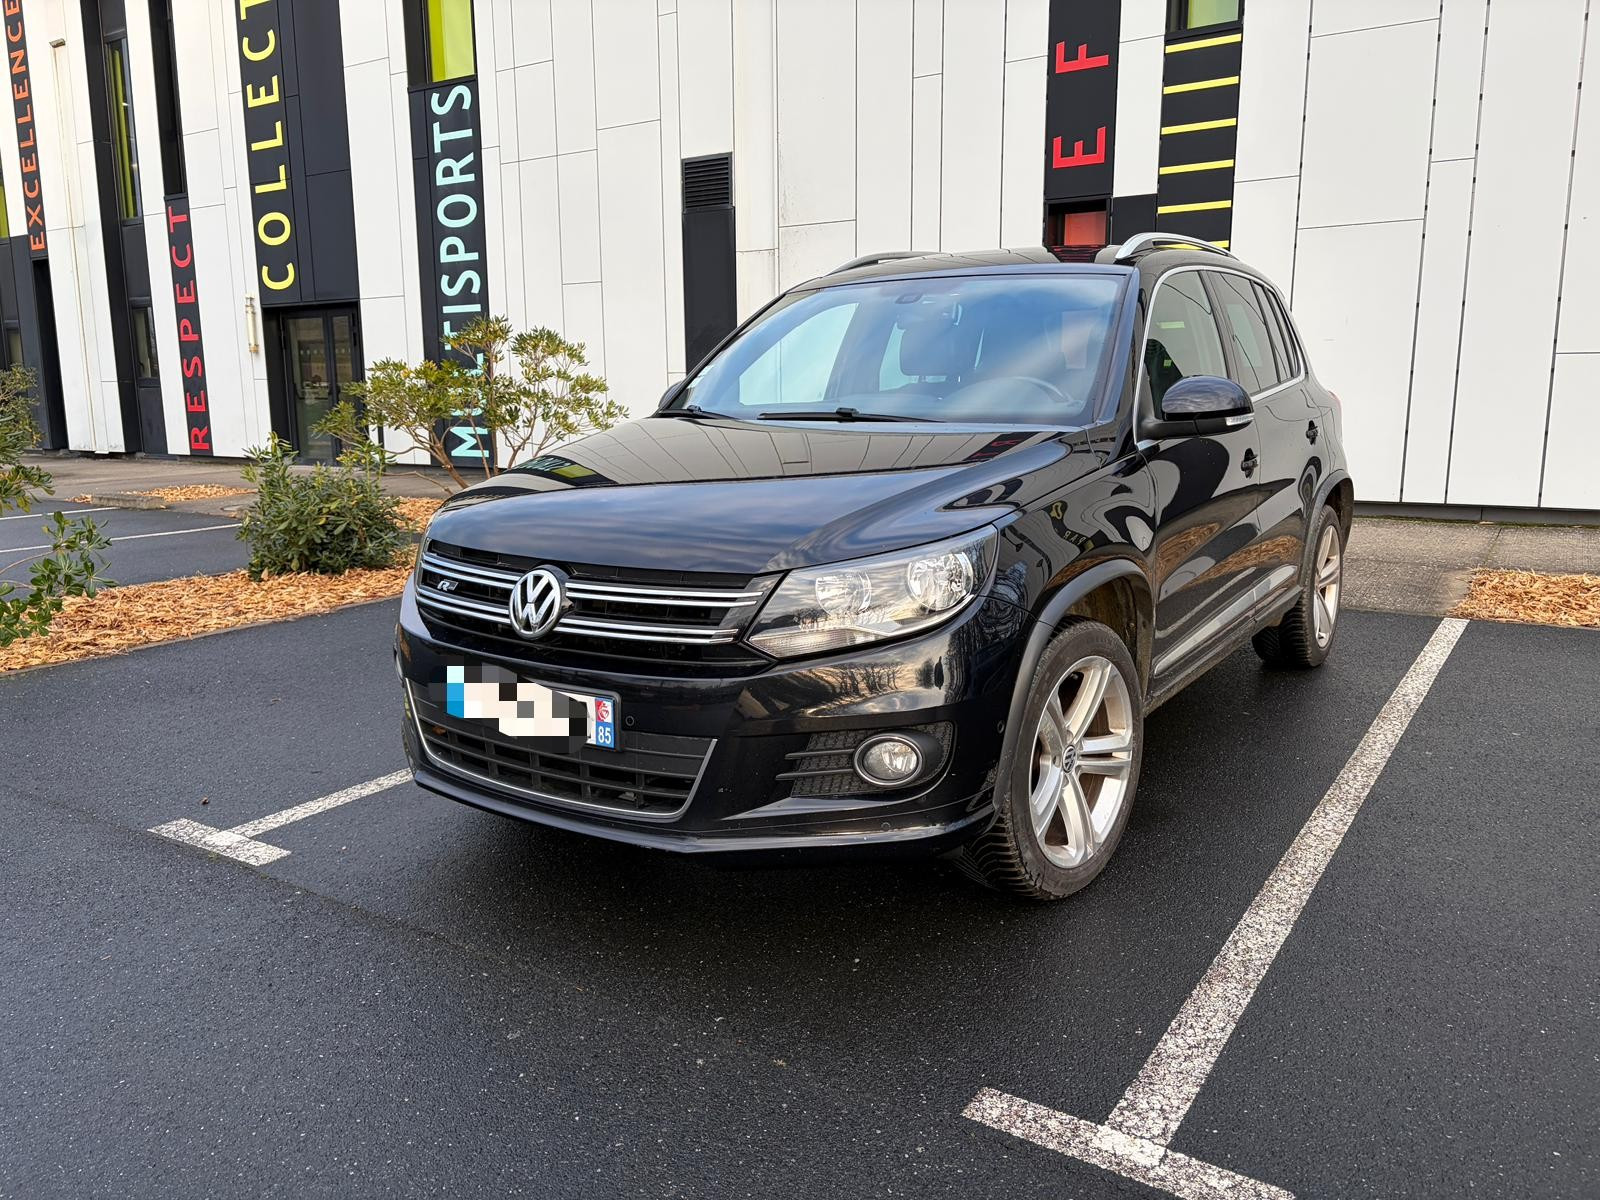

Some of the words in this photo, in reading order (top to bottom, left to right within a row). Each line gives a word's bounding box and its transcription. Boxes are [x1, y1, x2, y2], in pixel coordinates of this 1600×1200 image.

[5, 0, 46, 251] EXCELLENCE
[168, 206, 210, 451] RESPECT
[509, 569, 561, 634] VW
[598, 726, 612, 745] 85
